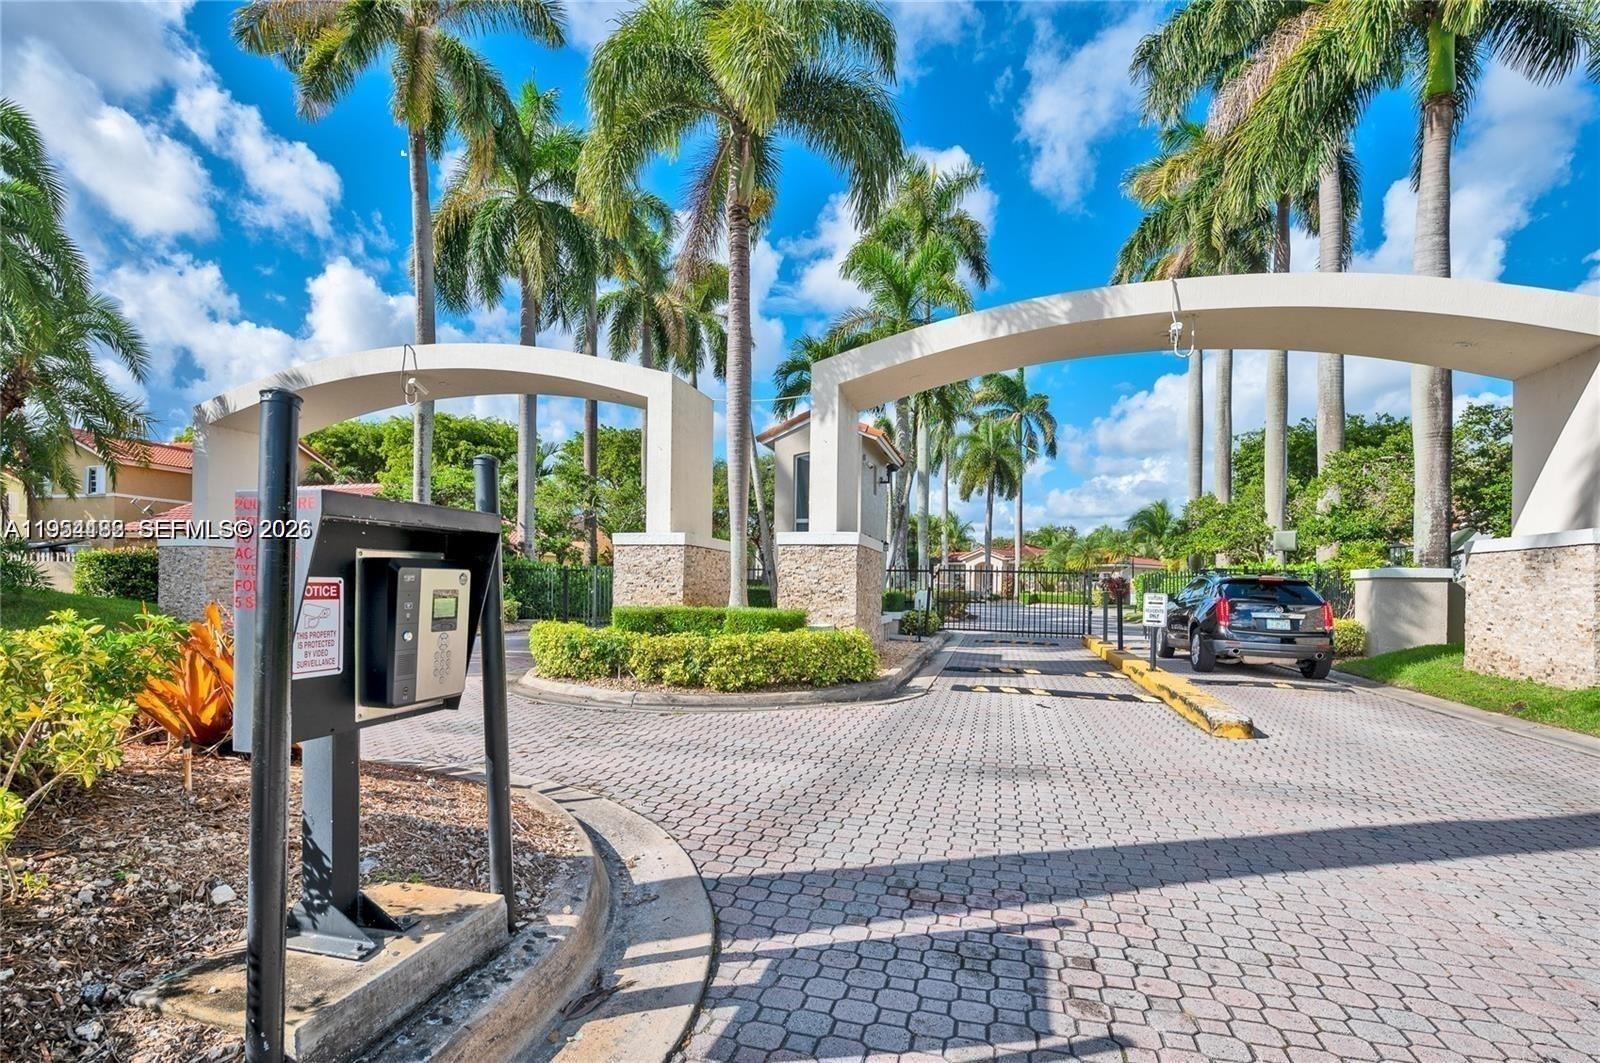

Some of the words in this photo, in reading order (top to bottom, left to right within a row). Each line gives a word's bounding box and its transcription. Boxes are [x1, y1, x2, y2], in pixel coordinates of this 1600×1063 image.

[305, 585, 338, 597] OTICE
[296, 632, 309, 640] THIS
[309, 631, 337, 640] PROPERTY
[298, 641, 304, 650] IS
[304, 640, 336, 649] PROTECTED
[304, 650, 312, 659] BY
[313, 649, 329, 658] VIDEO
[296, 658, 336, 669] SURVEILLANCE
